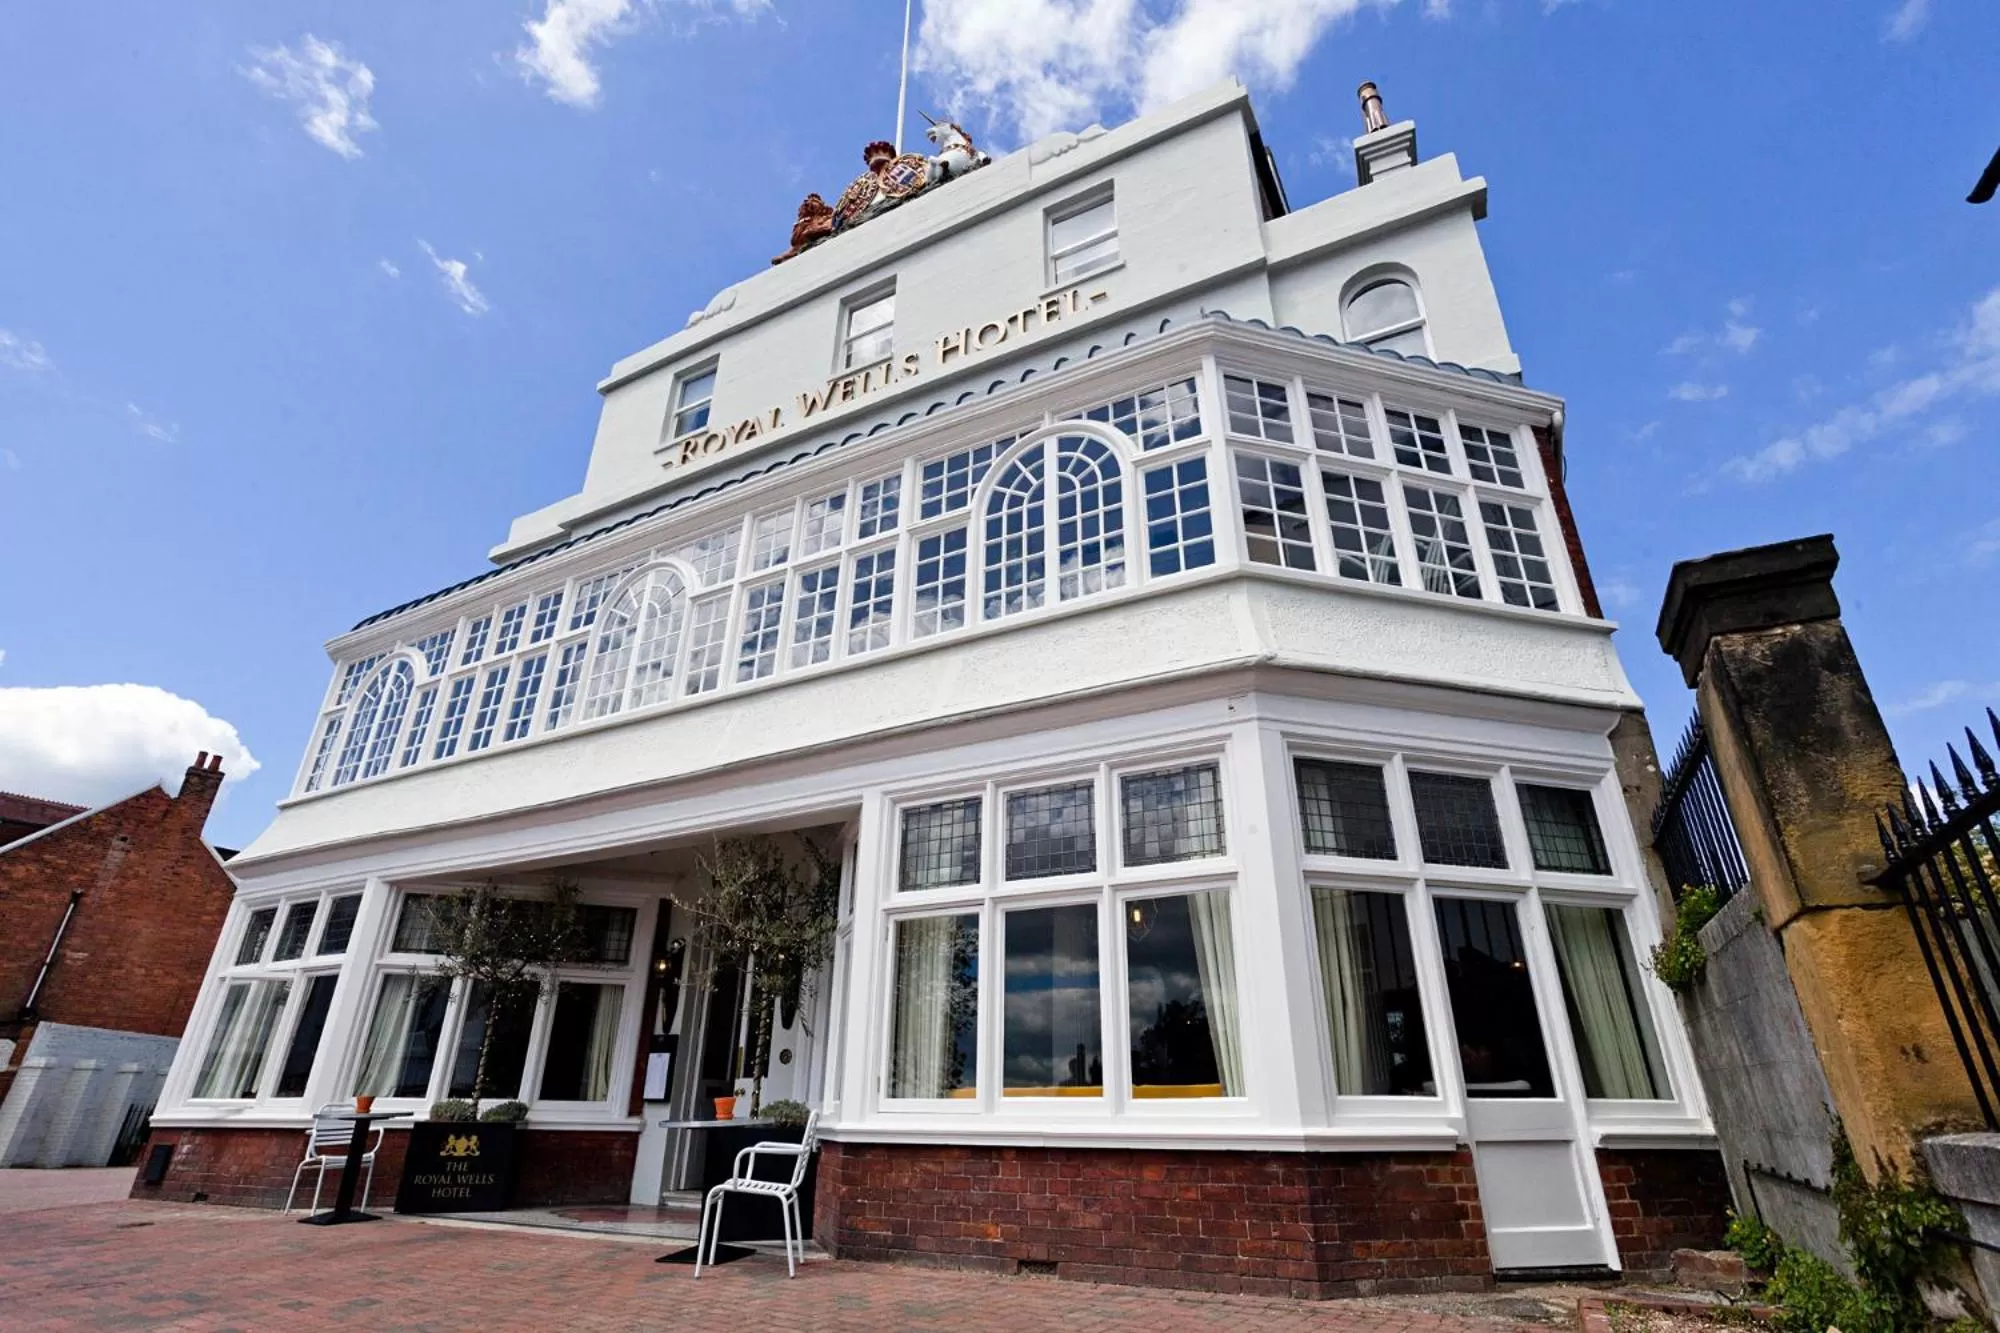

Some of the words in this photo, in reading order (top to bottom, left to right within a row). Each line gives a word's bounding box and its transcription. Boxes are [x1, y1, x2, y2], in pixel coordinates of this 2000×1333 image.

[796, 352, 920, 418] WELLS
[446, 1161, 469, 1172] THE
[414, 1173, 453, 1185] ROYAL
[457, 1173, 496, 1185] WELLS
[431, 1187, 473, 1199] HOTEL
